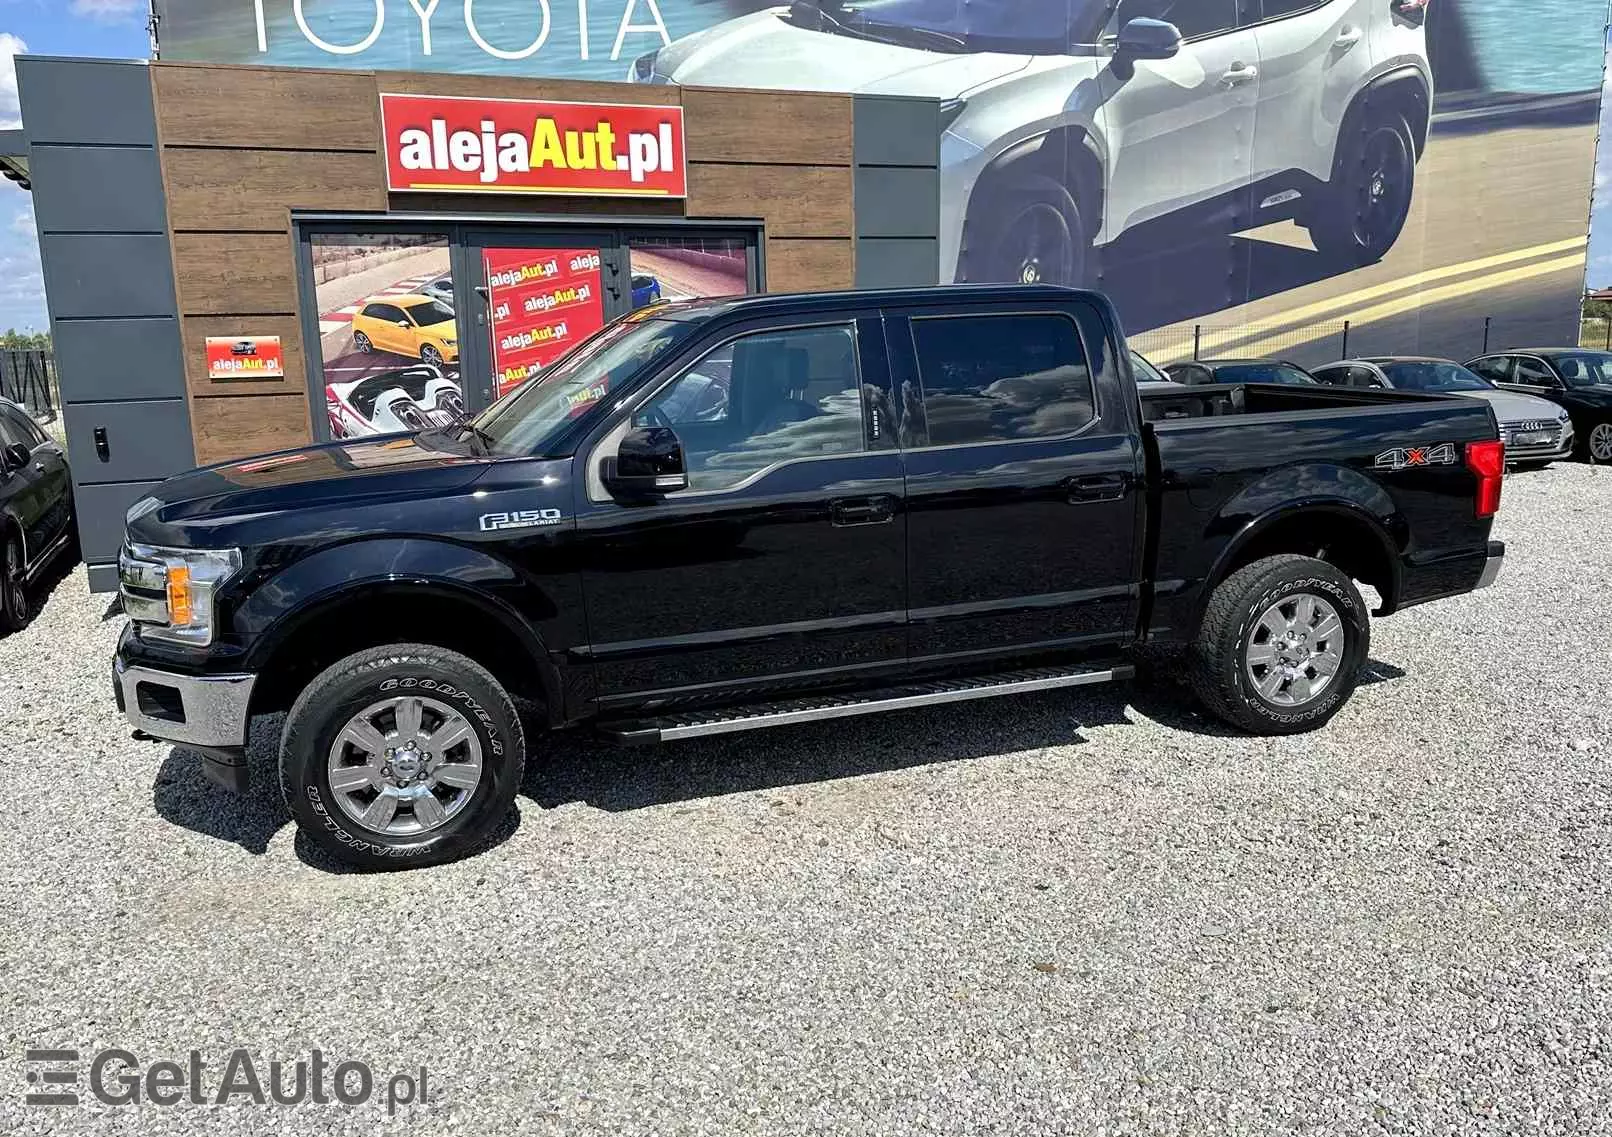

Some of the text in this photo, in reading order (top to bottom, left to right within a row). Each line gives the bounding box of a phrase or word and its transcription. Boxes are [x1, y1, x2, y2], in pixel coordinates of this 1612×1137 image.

[400, 118, 673, 183] alejaAut.pl
[490, 260, 558, 287] alejaAut.pl
[570, 254, 600, 271] aleja
[524, 284, 591, 311] alejaAut.pl
[501, 322, 568, 350] alejaAut.pl
[212, 357, 279, 371] alejaAut.pl
[379, 677, 504, 756] GOODYEAR
[307, 785, 432, 858] WRANGLER
